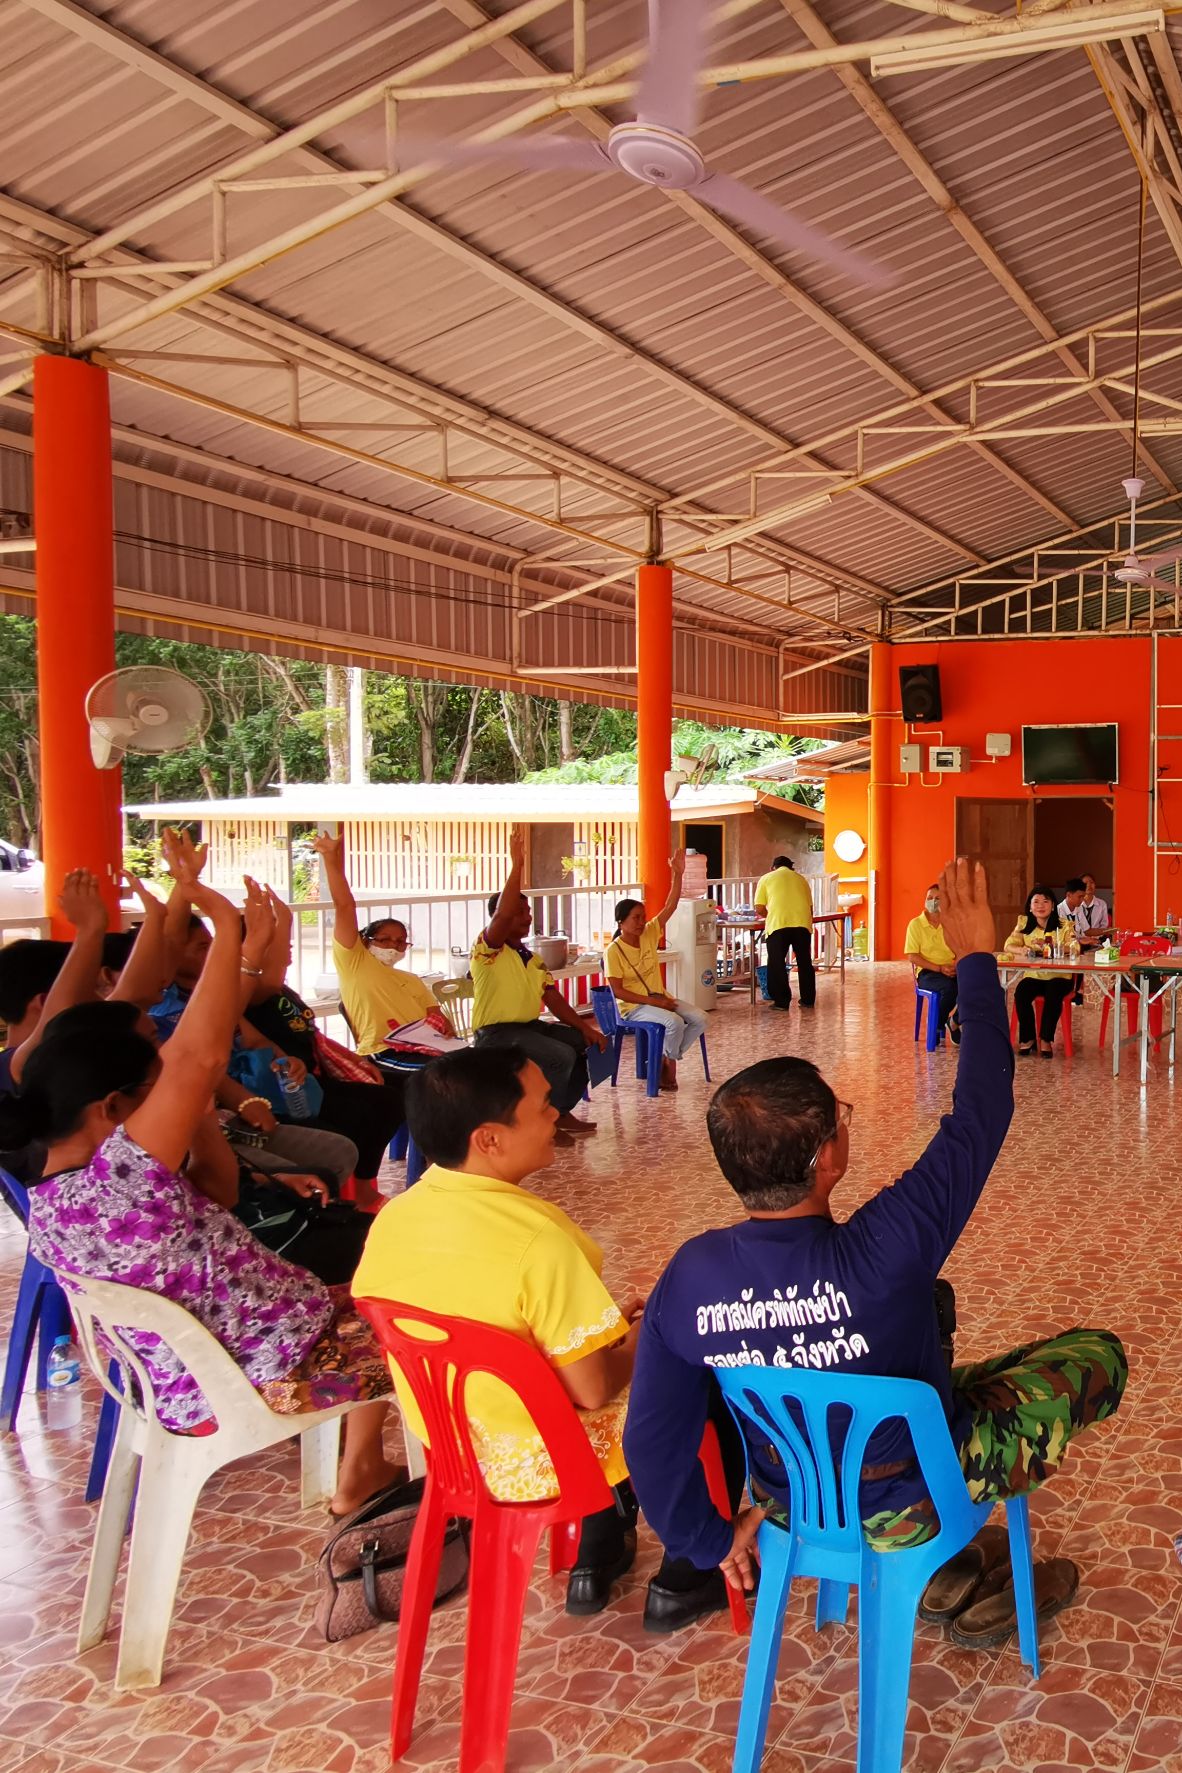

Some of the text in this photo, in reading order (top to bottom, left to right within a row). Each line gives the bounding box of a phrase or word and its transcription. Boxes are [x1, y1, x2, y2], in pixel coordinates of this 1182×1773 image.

[696, 1279, 852, 1335] อาสาสมัครพิทักษ์ป่า
[790, 1326, 870, 1369] จังหวัด
